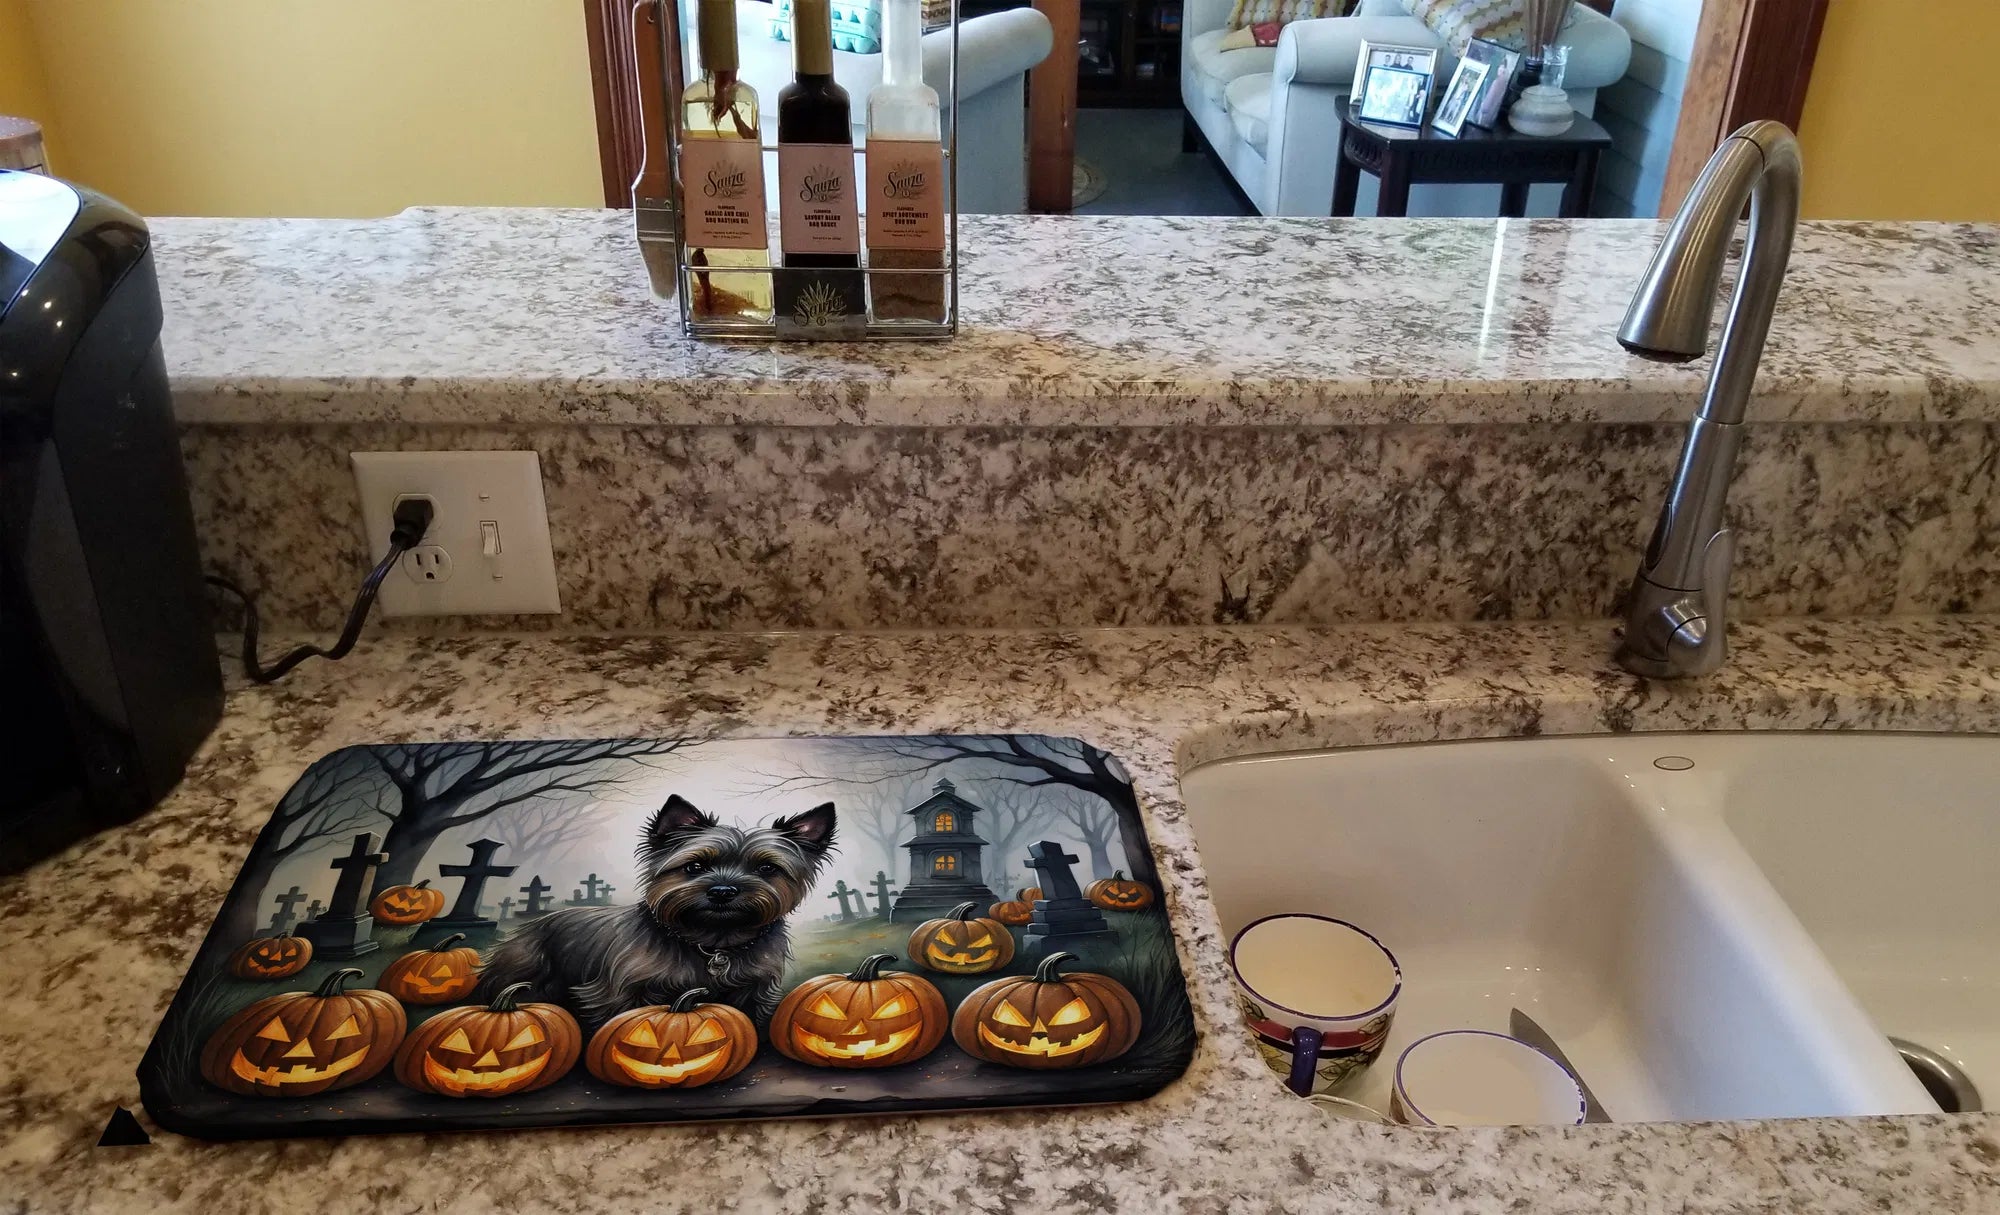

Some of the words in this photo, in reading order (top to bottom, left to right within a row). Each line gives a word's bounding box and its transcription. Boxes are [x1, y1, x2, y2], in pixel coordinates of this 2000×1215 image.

[704, 170, 746, 197] Sauza
[800, 175, 842, 202] Sauza
[883, 171, 926, 198] Sauza
